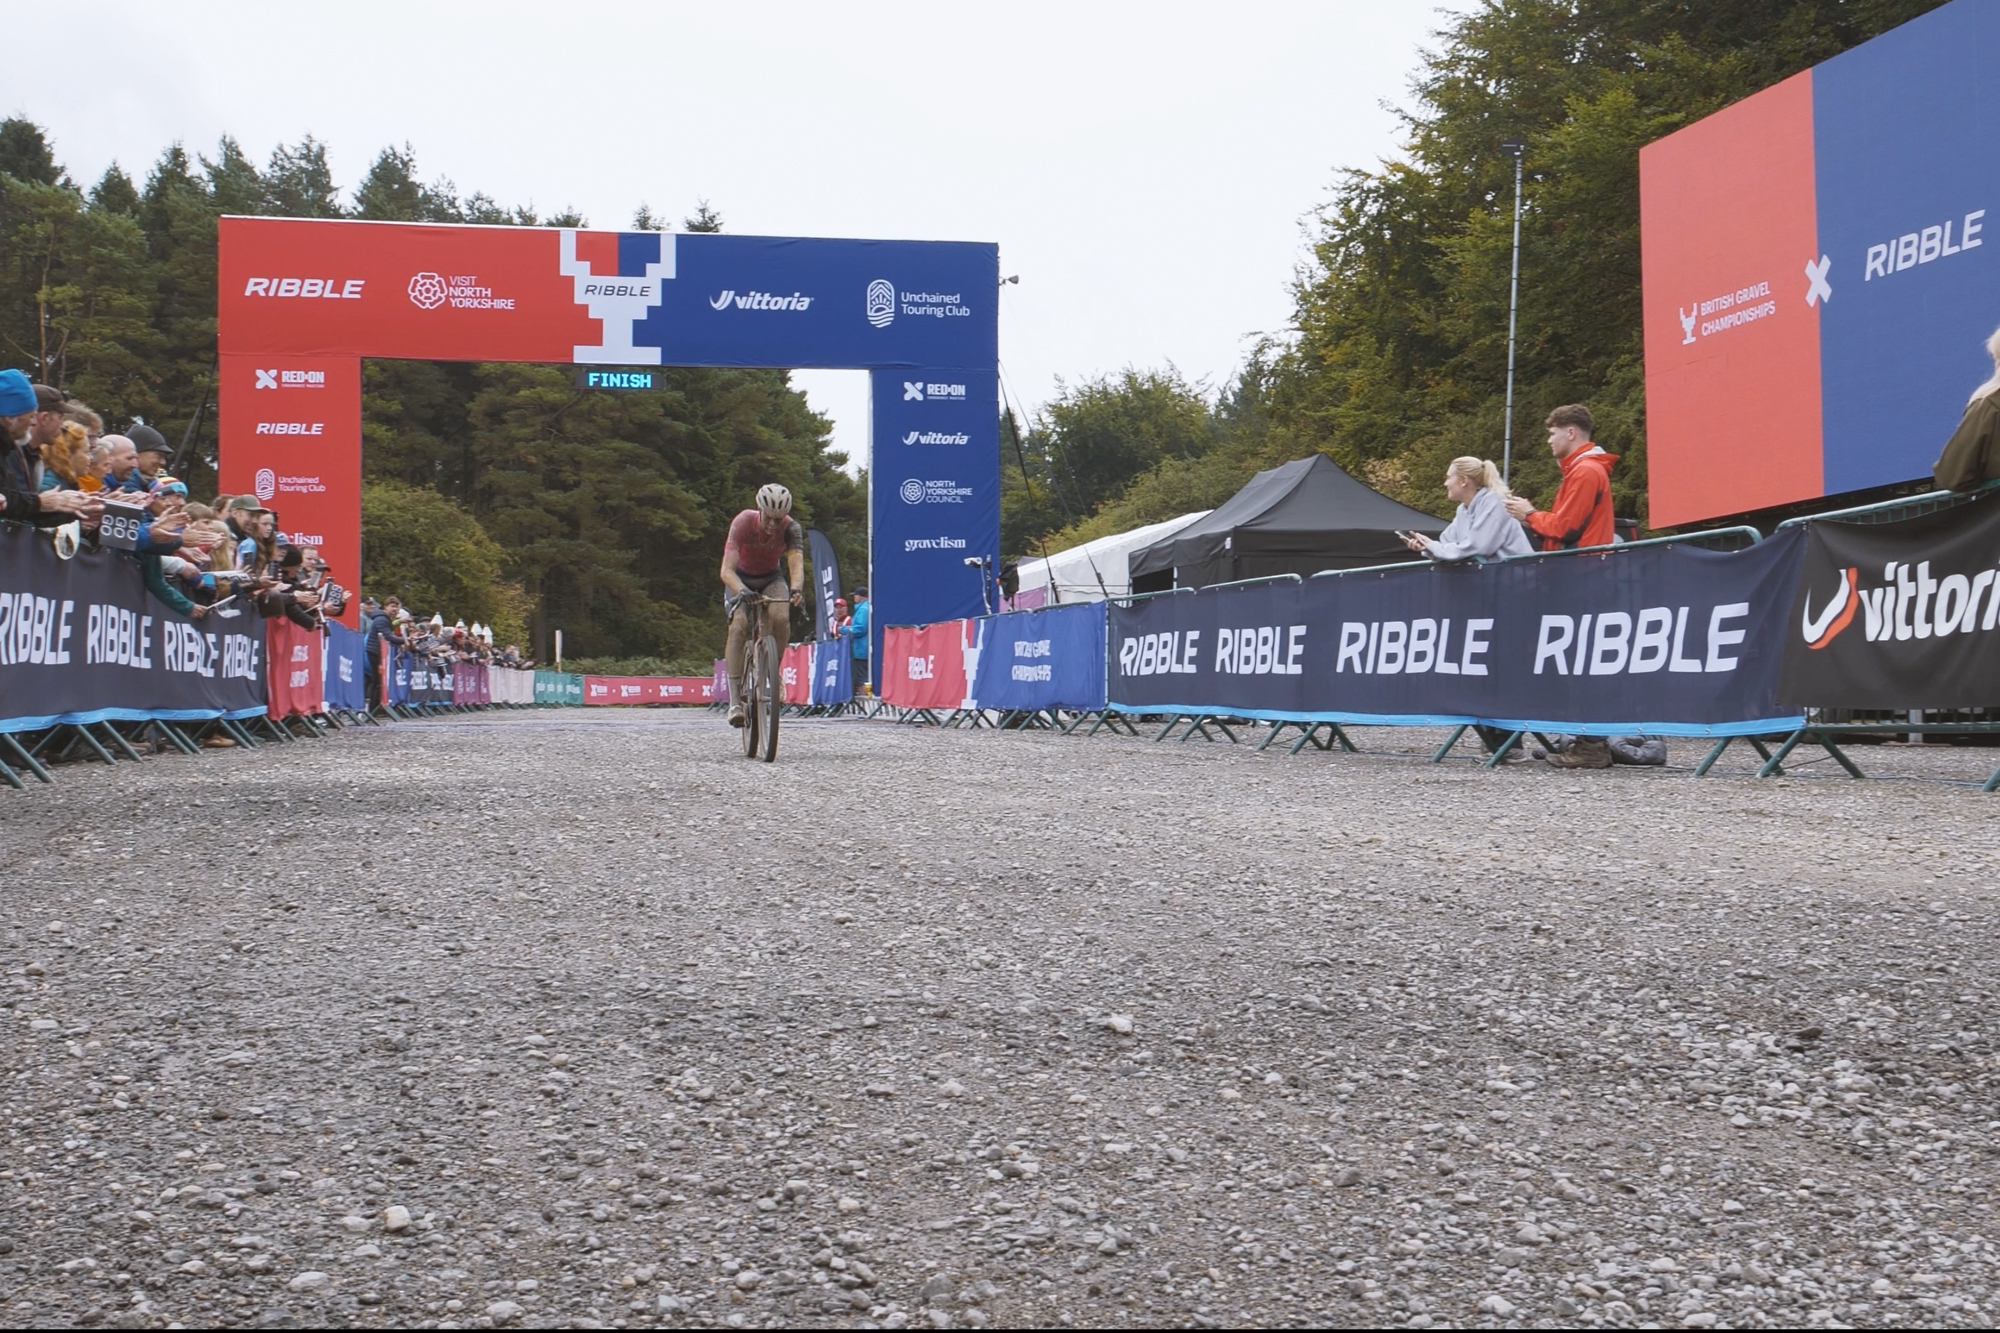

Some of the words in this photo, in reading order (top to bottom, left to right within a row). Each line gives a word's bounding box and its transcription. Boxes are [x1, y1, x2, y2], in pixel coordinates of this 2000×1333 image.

[1865, 210, 1985, 281] RIBBLE
[450, 276, 477, 286] VISIT
[245, 278, 365, 298] RIBBLE
[449, 287, 491, 297] NORTH
[585, 285, 650, 296] RIBBLE
[450, 298, 514, 309] YORKSHIRE
[901, 292, 960, 303] Unchained
[1701, 292, 1734, 316] BRITISH
[1735, 281, 1771, 304] GRAVEL
[902, 304, 944, 317] Touring
[946, 306, 970, 316] Club
[1701, 300, 1776, 336] CHAMPIONSHIPS
[589, 373, 654, 388] FINISH
[256, 423, 324, 434] RIBBLE
[918, 432, 969, 445] vittoria
[279, 477, 319, 485] Unchained
[926, 480, 956, 488] NORTH
[279, 484, 307, 493] Touring
[309, 484, 326, 493] Club
[926, 488, 973, 496] YORKSHIRE
[0, 593, 73, 665] RIBBLE
[87, 605, 151, 668] RIBBLE
[1534, 603, 1749, 675] RIBBLE
[1215, 626, 1306, 674] RIBBLE
[1336, 618, 1494, 675] RIBBLE
[1120, 631, 1200, 676] RIBBLE
